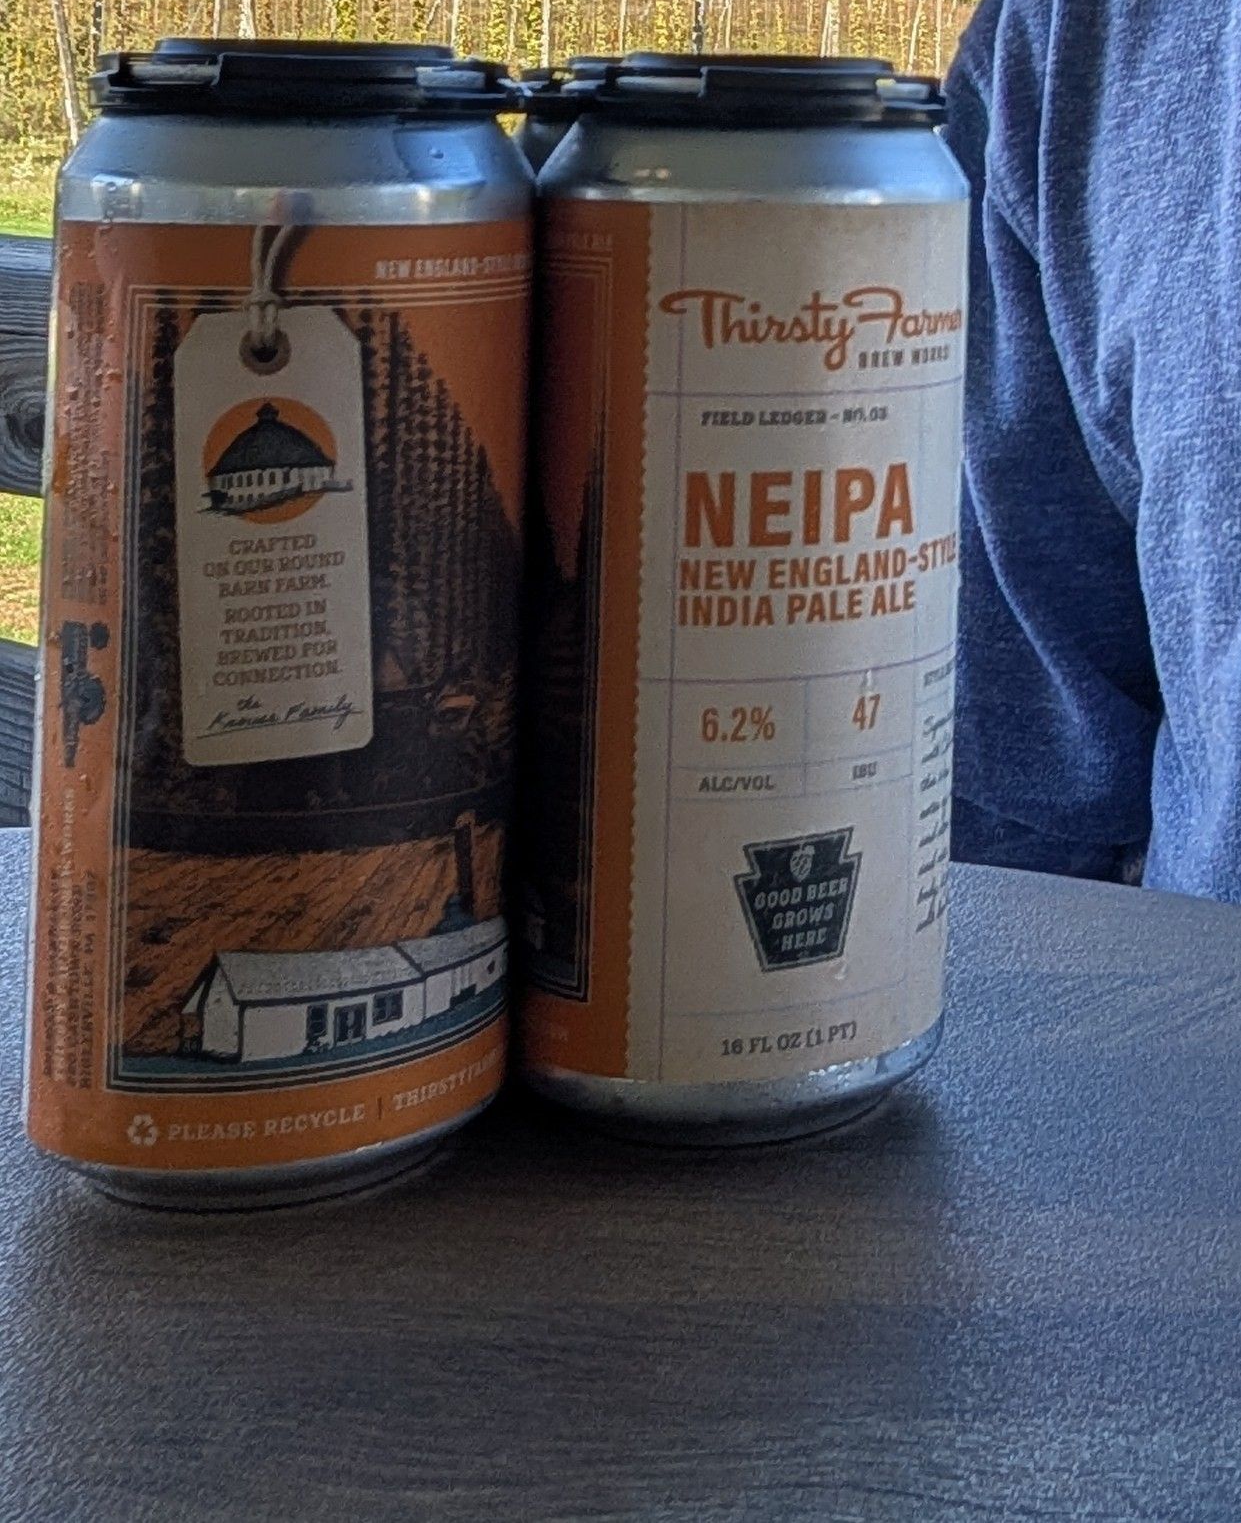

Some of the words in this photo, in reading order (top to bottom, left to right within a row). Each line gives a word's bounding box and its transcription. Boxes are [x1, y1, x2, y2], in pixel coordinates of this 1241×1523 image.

[658, 289, 855, 372] Thirsty
[858, 350, 904, 370] BREW
[911, 345, 950, 366] WORKS
[701, 409, 754, 427] FIELD
[758, 408, 827, 426] LEDGER
[684, 462, 914, 548] NEIPA
[229, 534, 316, 555] CRAFTED
[203, 561, 229, 578] ON
[234, 558, 272, 576] OUR
[279, 551, 344, 572] ROUND
[679, 557, 757, 591] NEW
[767, 531, 957, 590] ENGLAND-STYLE
[219, 579, 270, 598] BARN
[276, 574, 330, 594] FARM.
[225, 603, 299, 625] ROOTED
[306, 598, 326, 616] IN
[678, 594, 775, 627] INDIA
[787, 587, 863, 625] PALE
[870, 579, 917, 617] ALE
[220, 620, 330, 645] TRADITION.
[217, 644, 295, 666] BREWED
[302, 639, 336, 659] FOR
[213, 659, 341, 687] CONNECTION.
[701, 705, 776, 743] 6.2%
[852, 693, 880, 731] 47
[698, 774, 777, 793] ALC/VOL
[852, 760, 878, 780] IBU
[754, 885, 801, 911] GOOD
[806, 877, 849, 901] BEER
[772, 902, 833, 931] GROWS
[780, 927, 828, 953] HERE
[721, 1037, 744, 1056] 16
[748, 1036, 773, 1055] FL
[776, 1032, 802, 1051] OZ
[829, 1019, 858, 1042] PT)
[167, 1120, 255, 1143] PLEASE
[263, 1103, 366, 1137] RECYCLE
